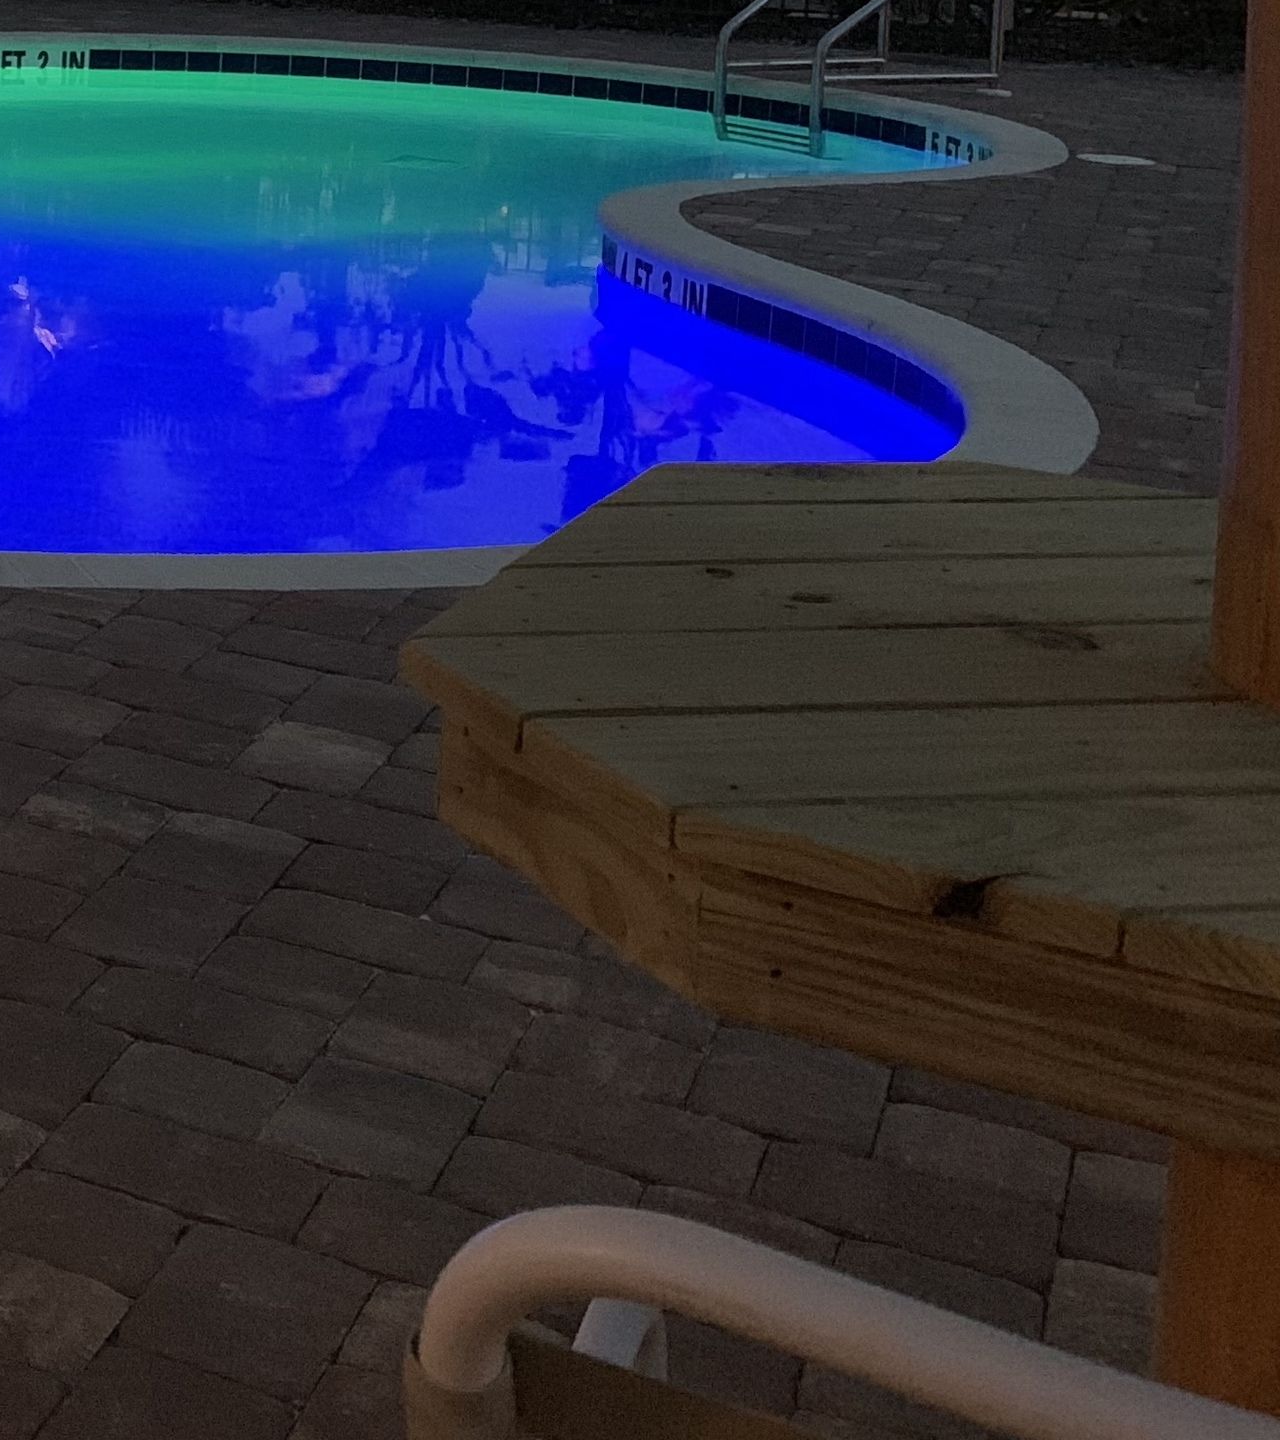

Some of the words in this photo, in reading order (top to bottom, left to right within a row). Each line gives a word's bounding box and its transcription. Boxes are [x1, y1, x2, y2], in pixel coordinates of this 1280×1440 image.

[2, 50, 26, 69] FT
[62, 51, 85, 69] IN
[946, 135, 961, 161] FT
[634, 257, 653, 295] FT
[682, 278, 704, 315] IN
